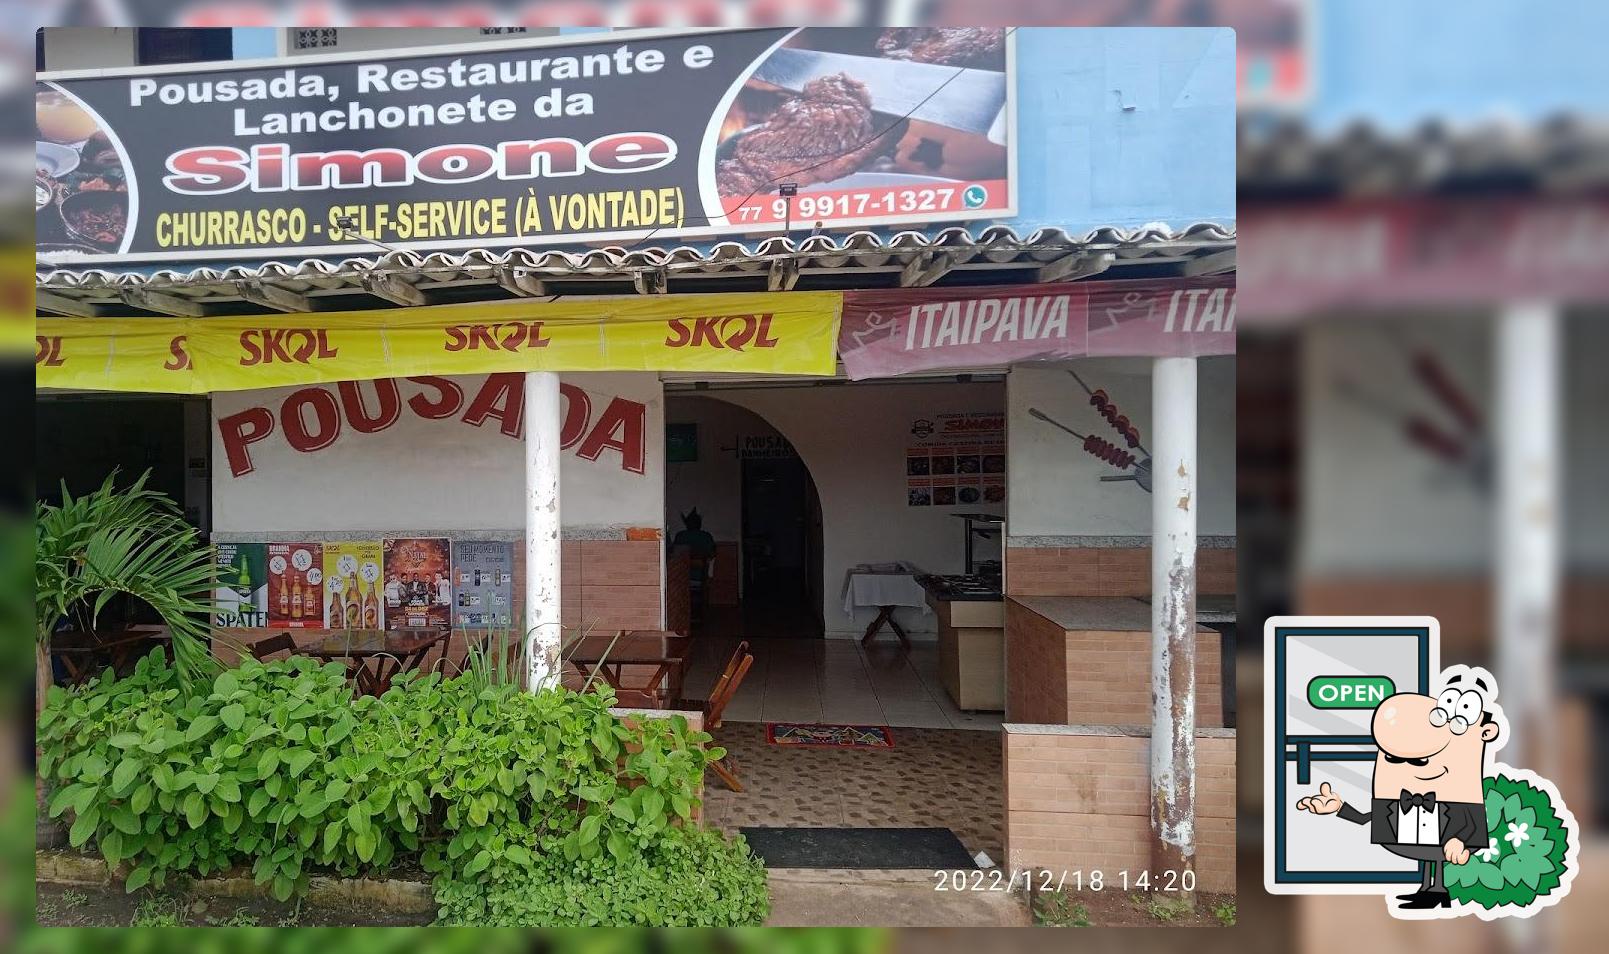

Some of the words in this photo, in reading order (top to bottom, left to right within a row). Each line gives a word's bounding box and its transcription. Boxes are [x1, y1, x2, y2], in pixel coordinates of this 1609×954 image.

[129, 69, 340, 107] Pousada,
[357, 47, 665, 93] Restaurante
[683, 44, 714, 69] e
[234, 92, 514, 136] Lanchonete
[534, 88, 594, 118] da
[163, 131, 678, 195] Simone
[156, 207, 306, 248] CHURRASCO
[328, 198, 506, 242] SELF-SERVICE
[514, 188, 543, 238] (À
[549, 186, 684, 230] VONTADE)
[739, 206, 762, 221] 77
[772, 199, 788, 219] 9
[799, 188, 955, 217] 9917-1327
[665, 313, 779, 350] SKOL
[905, 296, 1070, 351] ITAIPAVA
[164, 336, 193, 370] S
[239, 328, 339, 367] SKOL
[216, 611, 268, 628] SPATE
